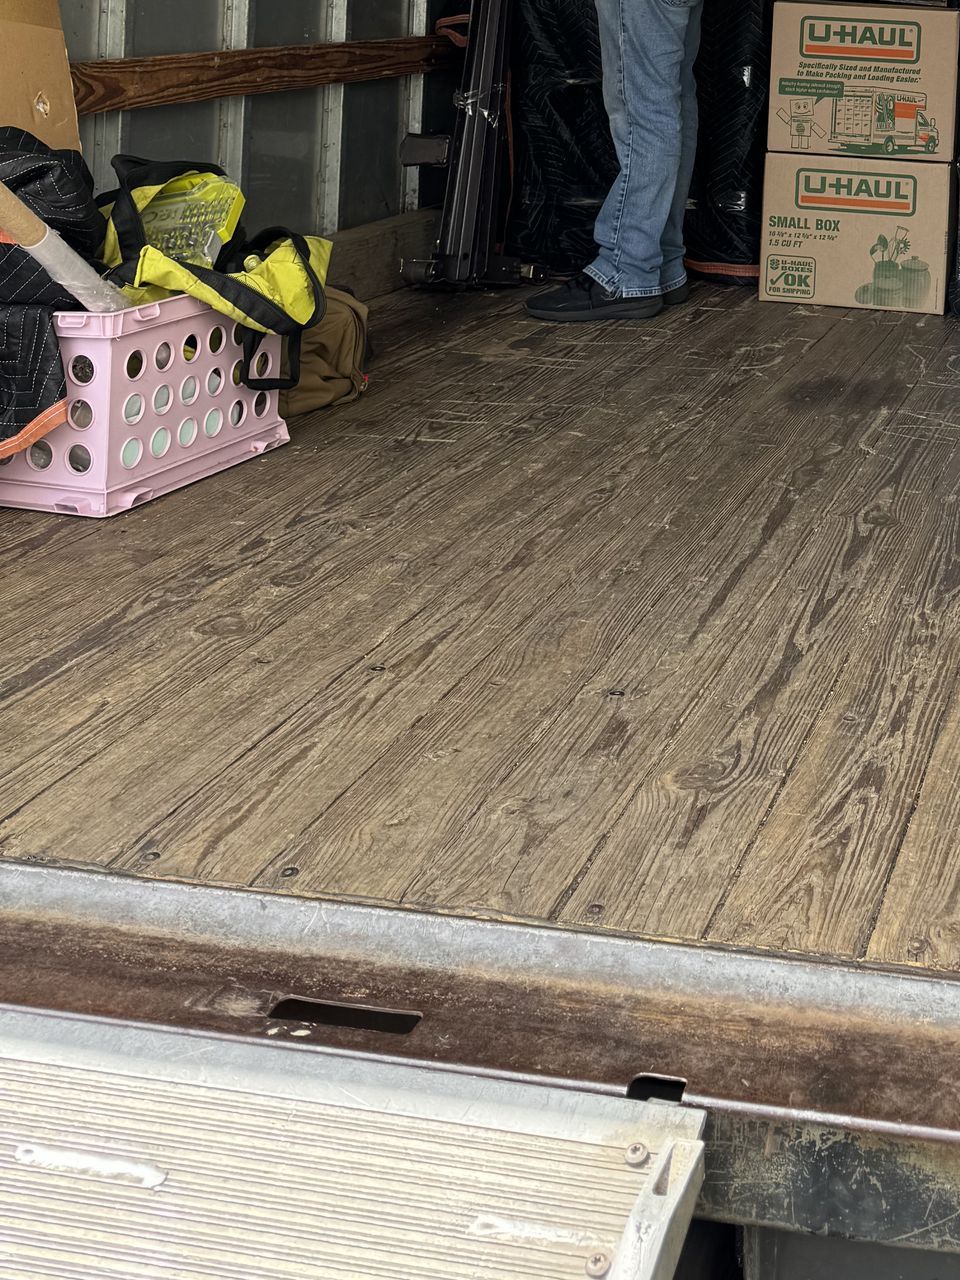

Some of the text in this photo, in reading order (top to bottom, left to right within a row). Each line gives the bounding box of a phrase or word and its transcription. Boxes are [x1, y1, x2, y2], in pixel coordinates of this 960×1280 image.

[808, 23, 913, 47] U-HAUL
[798, 61, 921, 75] Specifically Sized and Manufactured
[805, 70, 824, 78] Make
[824, 71, 852, 81] Packing
[853, 72, 866, 80] and
[867, 74, 895, 83] Loading
[804, 175, 909, 200] U-HAUL
[769, 215, 841, 232] SMALL BOX
[768, 239, 803, 248] 1.5 CU FT
[781, 259, 813, 267] U-HAUL
[784, 273, 811, 288] OK
[782, 287, 811, 295] SHIPPING
